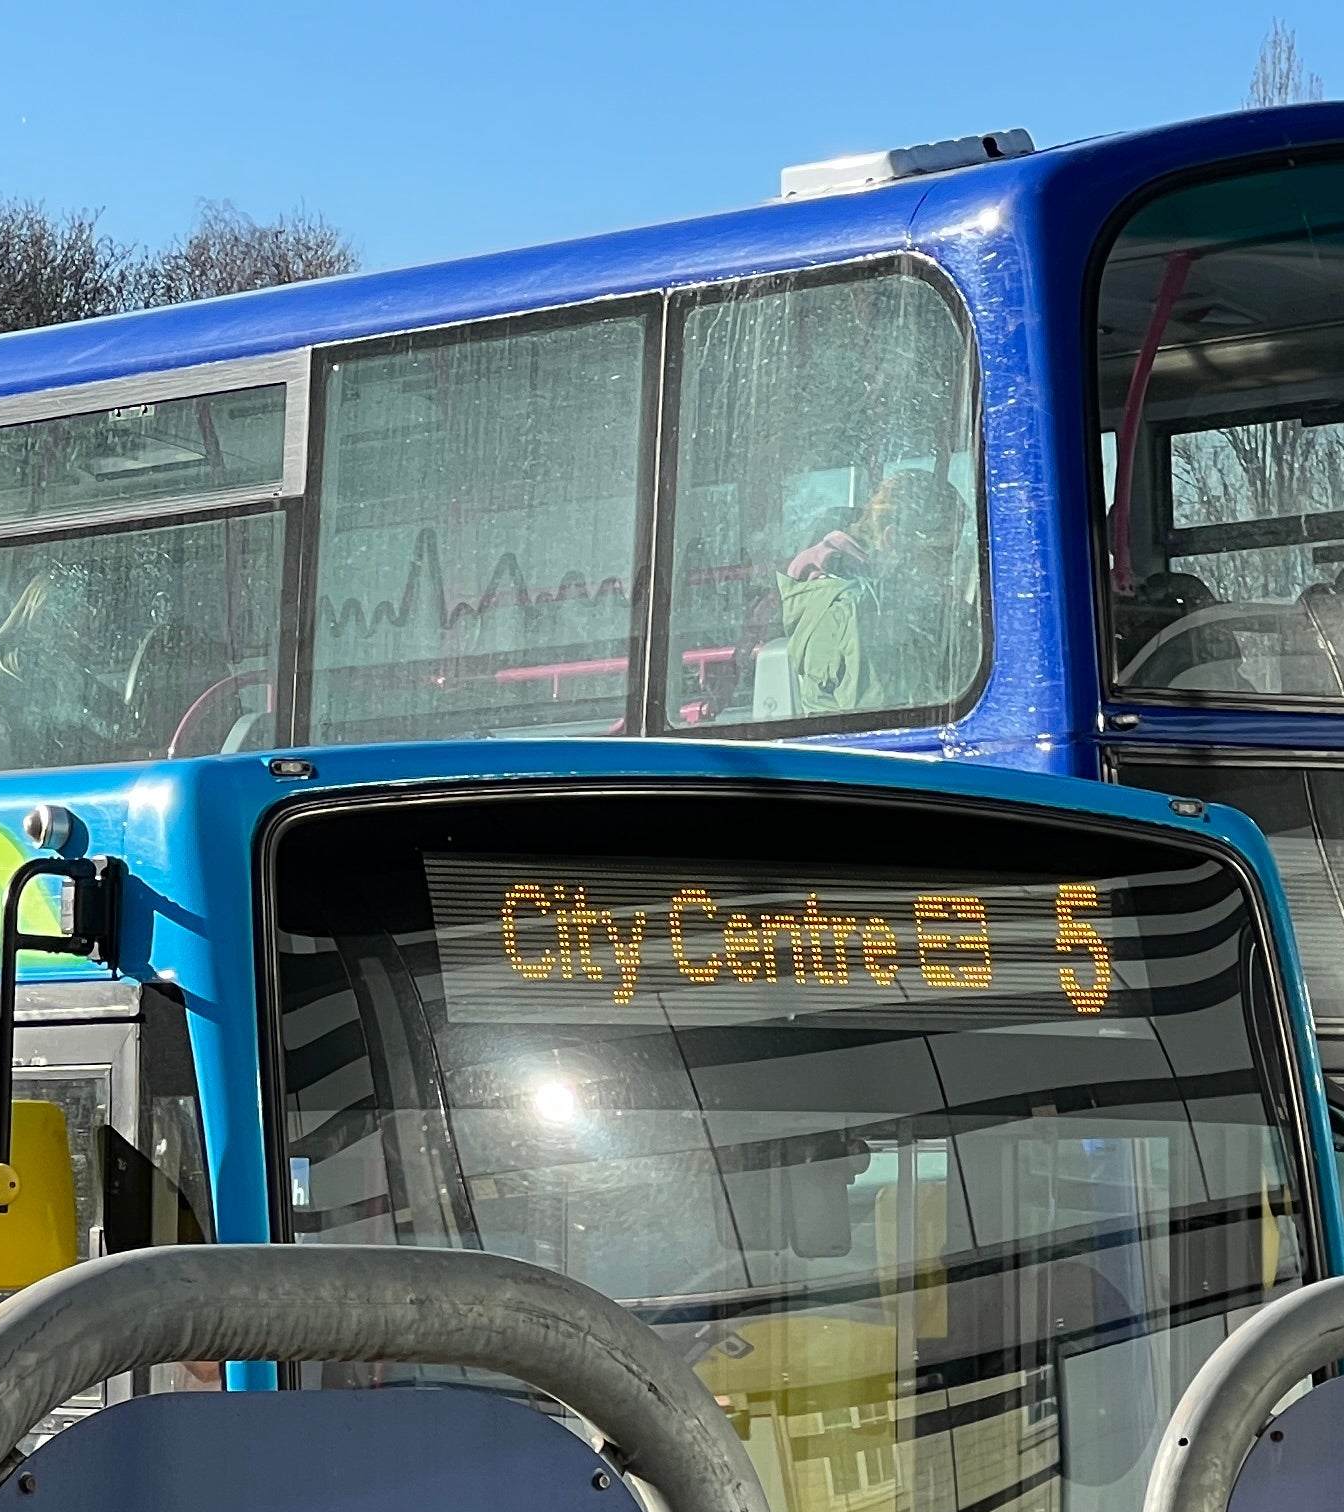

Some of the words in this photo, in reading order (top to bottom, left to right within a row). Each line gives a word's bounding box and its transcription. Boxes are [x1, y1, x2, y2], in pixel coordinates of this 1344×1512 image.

[501, 882, 647, 1005] City
[668, 887, 898, 986] Centre
[1055, 884, 1112, 1014] 5
